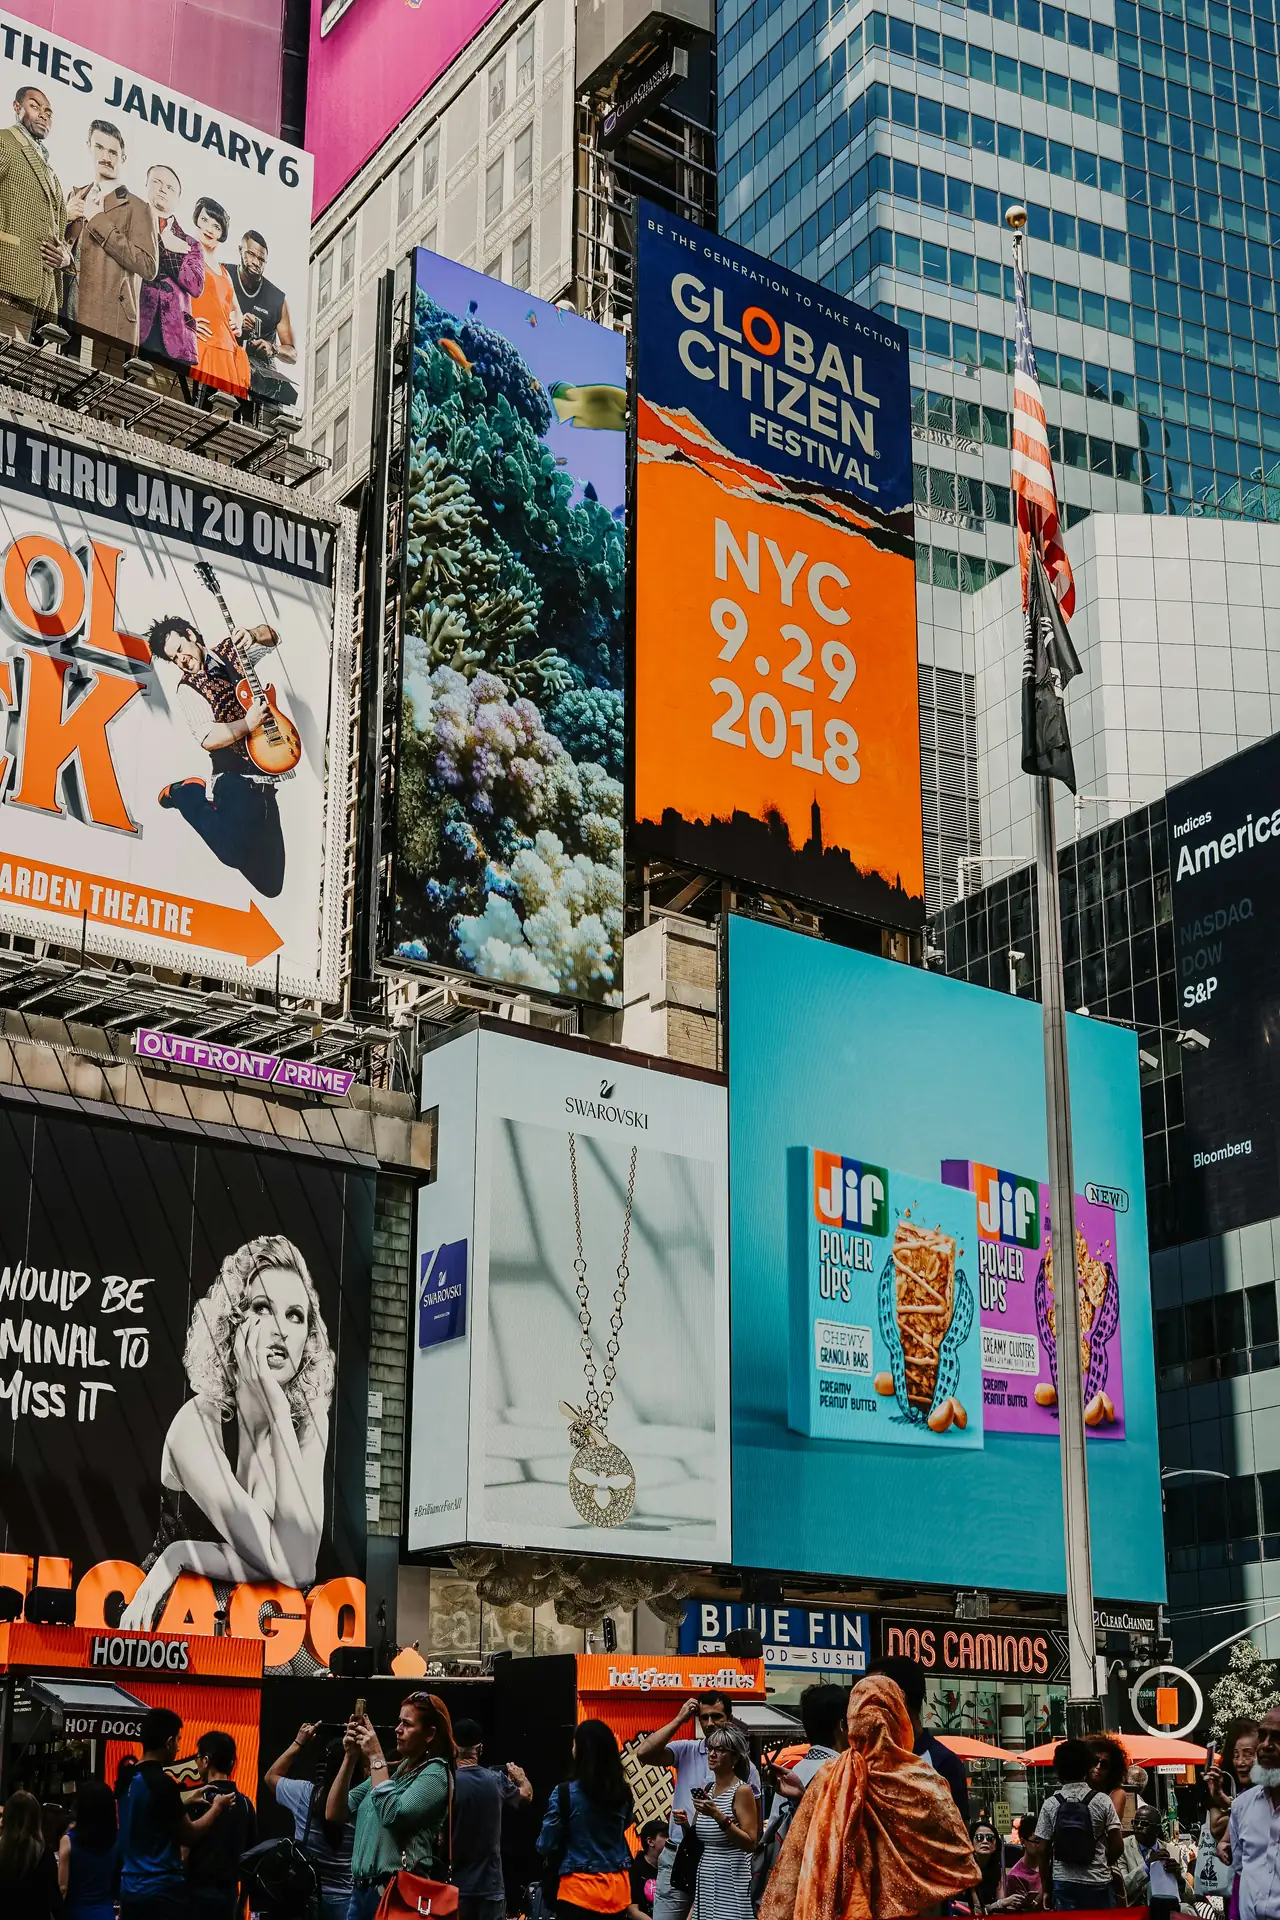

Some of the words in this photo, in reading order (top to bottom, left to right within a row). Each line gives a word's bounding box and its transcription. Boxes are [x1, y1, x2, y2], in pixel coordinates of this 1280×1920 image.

[1, 23, 93, 93] THES
[104, 76, 274, 175] JANUARY
[278, 155, 300, 188] 6
[647, 219, 665, 235] BE
[671, 230, 697, 251] THE
[703, 247, 790, 297] GENERATION
[795, 292, 812, 307] TO
[817, 302, 850, 327] TAKE
[854, 322, 901, 352] ACTION
[671, 273, 881, 408] GLOBAL
[678, 329, 876, 457] CITIZEN
[750, 412, 879, 493] FESTIVAL
[26, 437, 117, 508] THRU
[126, 473, 194, 533] JAN
[202, 495, 244, 546] 20
[252, 511, 331, 573] ONLY
[714, 516, 851, 626] NYC
[709, 597, 857, 703] 9.29
[0, 646, 148, 838] K
[709, 677, 861, 785] 2018
[1174, 811, 1213, 838] Indices
[0, 862, 82, 911] ARDEN
[89, 883, 194, 937] THEATRE
[1180, 898, 1254, 946] NASDAQ
[1182, 941, 1222, 978] DOW
[1183, 976, 1218, 1008] S&P
[143, 1034, 271, 1078] OUTFRONT
[284, 1066, 347, 1093] PRIME
[565, 1097, 649, 1131] SWAROVSKI
[1193, 1137, 1253, 1168] Bloomberg
[818, 1164, 885, 1227] Jif
[977, 1179, 1036, 1237] Jif
[1091, 1187, 1125, 1208] NEW!
[819, 1229, 873, 1273] POWER
[978, 1239, 1024, 1283] POWER
[0, 1260, 91, 1311] WOULD
[100, 1275, 156, 1314] BE
[423, 1283, 462, 1308] SWAROVSKI
[819, 1257, 851, 1303] UPS
[978, 1268, 1007, 1314] UPS
[0, 1318, 110, 1369] MINAL
[113, 1327, 150, 1369] TO
[820, 1346, 850, 1366] GRANOLA
[853, 1351, 869, 1369] BARS
[823, 1330, 865, 1349] CHEWY
[983, 1336, 1006, 1355] CREAMY
[1009, 1340, 1035, 1360] CLUSTERS
[78, 1381, 117, 1422] IT
[819, 1380, 852, 1395] CREAMY
[819, 1394, 848, 1409] PEANUT
[850, 1397, 877, 1412] BUTTER
[983, 1377, 1008, 1392] CREAMY
[983, 1392, 1006, 1406] PEANUT
[1007, 1394, 1028, 1408] BUTTER
[414, 1497, 463, 1517] #BrillianceForAll
[701, 1603, 790, 1643] BLUE
[809, 1612, 862, 1648] FIN
[811, 1651, 864, 1667] SUSHI
[888, 1627, 936, 1668] DOS
[943, 1630, 1049, 1674] CAMINOS
[608, 1666, 683, 1692] belgian
[688, 1668, 755, 1688] waffles
[65, 1718, 97, 1733] HOT
[101, 1719, 142, 1737] DOGS
